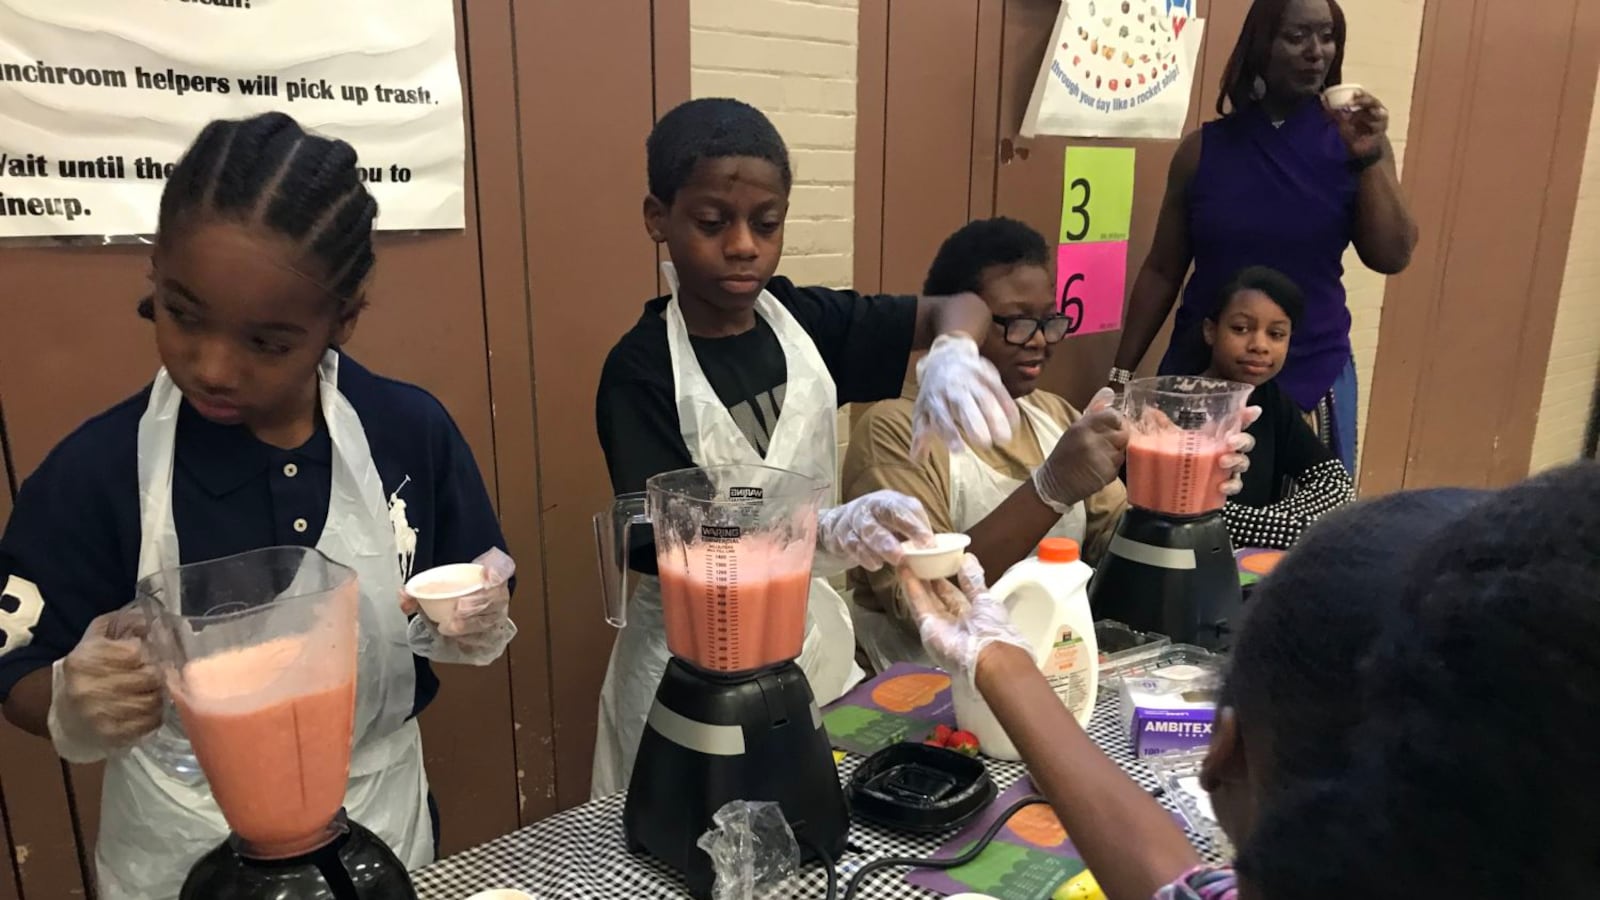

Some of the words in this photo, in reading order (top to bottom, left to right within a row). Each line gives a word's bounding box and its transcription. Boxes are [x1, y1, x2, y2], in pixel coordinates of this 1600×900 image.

[0, 61, 127, 88] nchroom
[135, 67, 230, 95] helpers
[237, 74, 277, 96] will
[286, 78, 334, 101] pick
[341, 85, 369, 105] up
[1112, 98, 1128, 111] like
[1130, 97, 1136, 108] a
[0, 153, 48, 177] ait
[58, 155, 125, 179] until
[390, 163, 411, 183] to
[1066, 177, 1091, 241] 3
[1061, 272, 1085, 334] 6
[702, 527, 739, 538] WARING
[1144, 721, 1213, 734] AMBITEX
